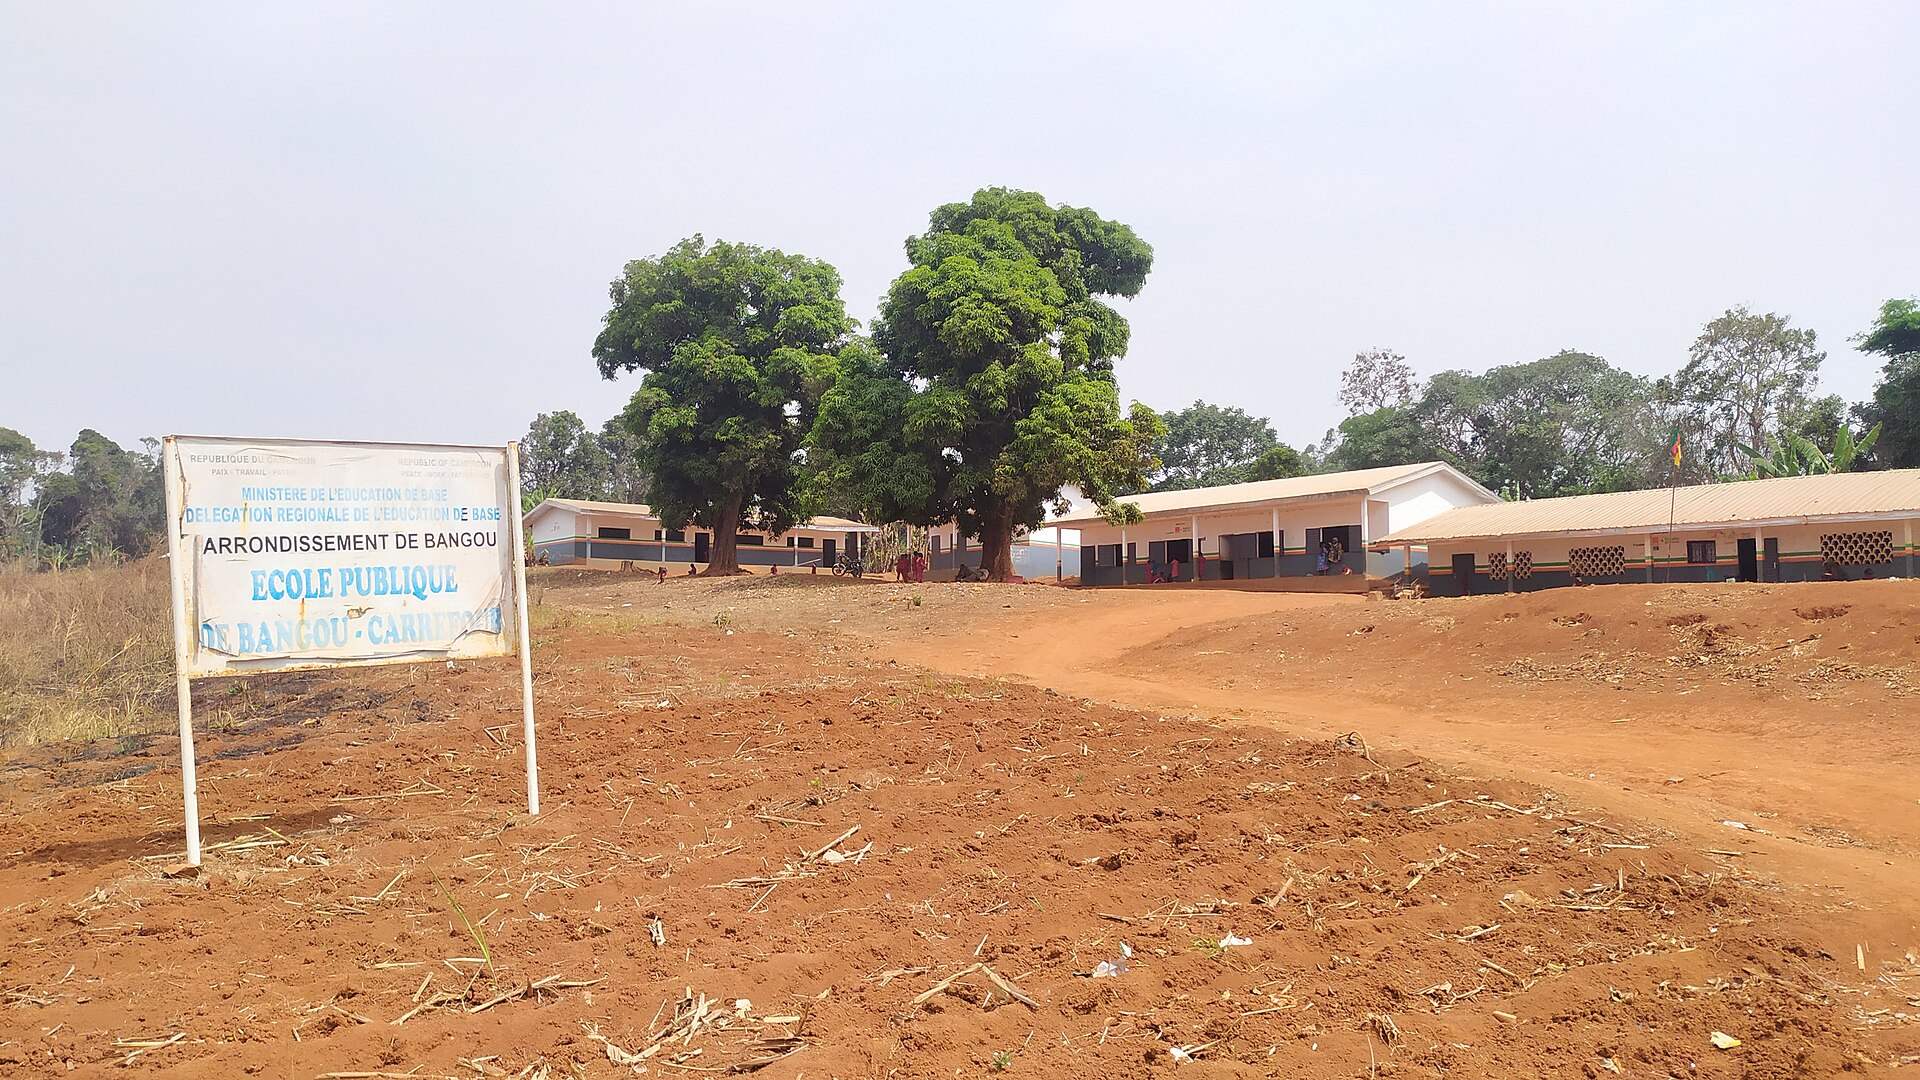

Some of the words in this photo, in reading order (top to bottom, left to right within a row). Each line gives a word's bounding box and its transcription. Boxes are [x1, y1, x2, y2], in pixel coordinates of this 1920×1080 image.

[190, 455, 249, 464] REPUBLIQUE
[252, 456, 264, 464] DU
[398, 458, 436, 466] REPUBLIC
[242, 488, 306, 501] MINISTERE
[311, 488, 324, 501] DE
[329, 488, 400, 501] L'EDUCATION
[405, 488, 417, 500] DE
[421, 489, 447, 501] BASE
[186, 507, 272, 523] DELEGATION
[277, 507, 349, 522] REGIONALE
[354, 507, 369, 521] DE
[373, 507, 449, 521] L'EDUCATION
[454, 507, 467, 521] DE
[472, 507, 501, 520] BASE
[203, 534, 388, 554] ARRONDISSEMENT
[396, 533, 418, 549] DE
[425, 532, 496, 549] BANGOU
[251, 568, 333, 601] ECOLE
[338, 565, 458, 600] PUBLIQUE
[202, 622, 231, 653] DE
[237, 617, 348, 653] BANGOU
